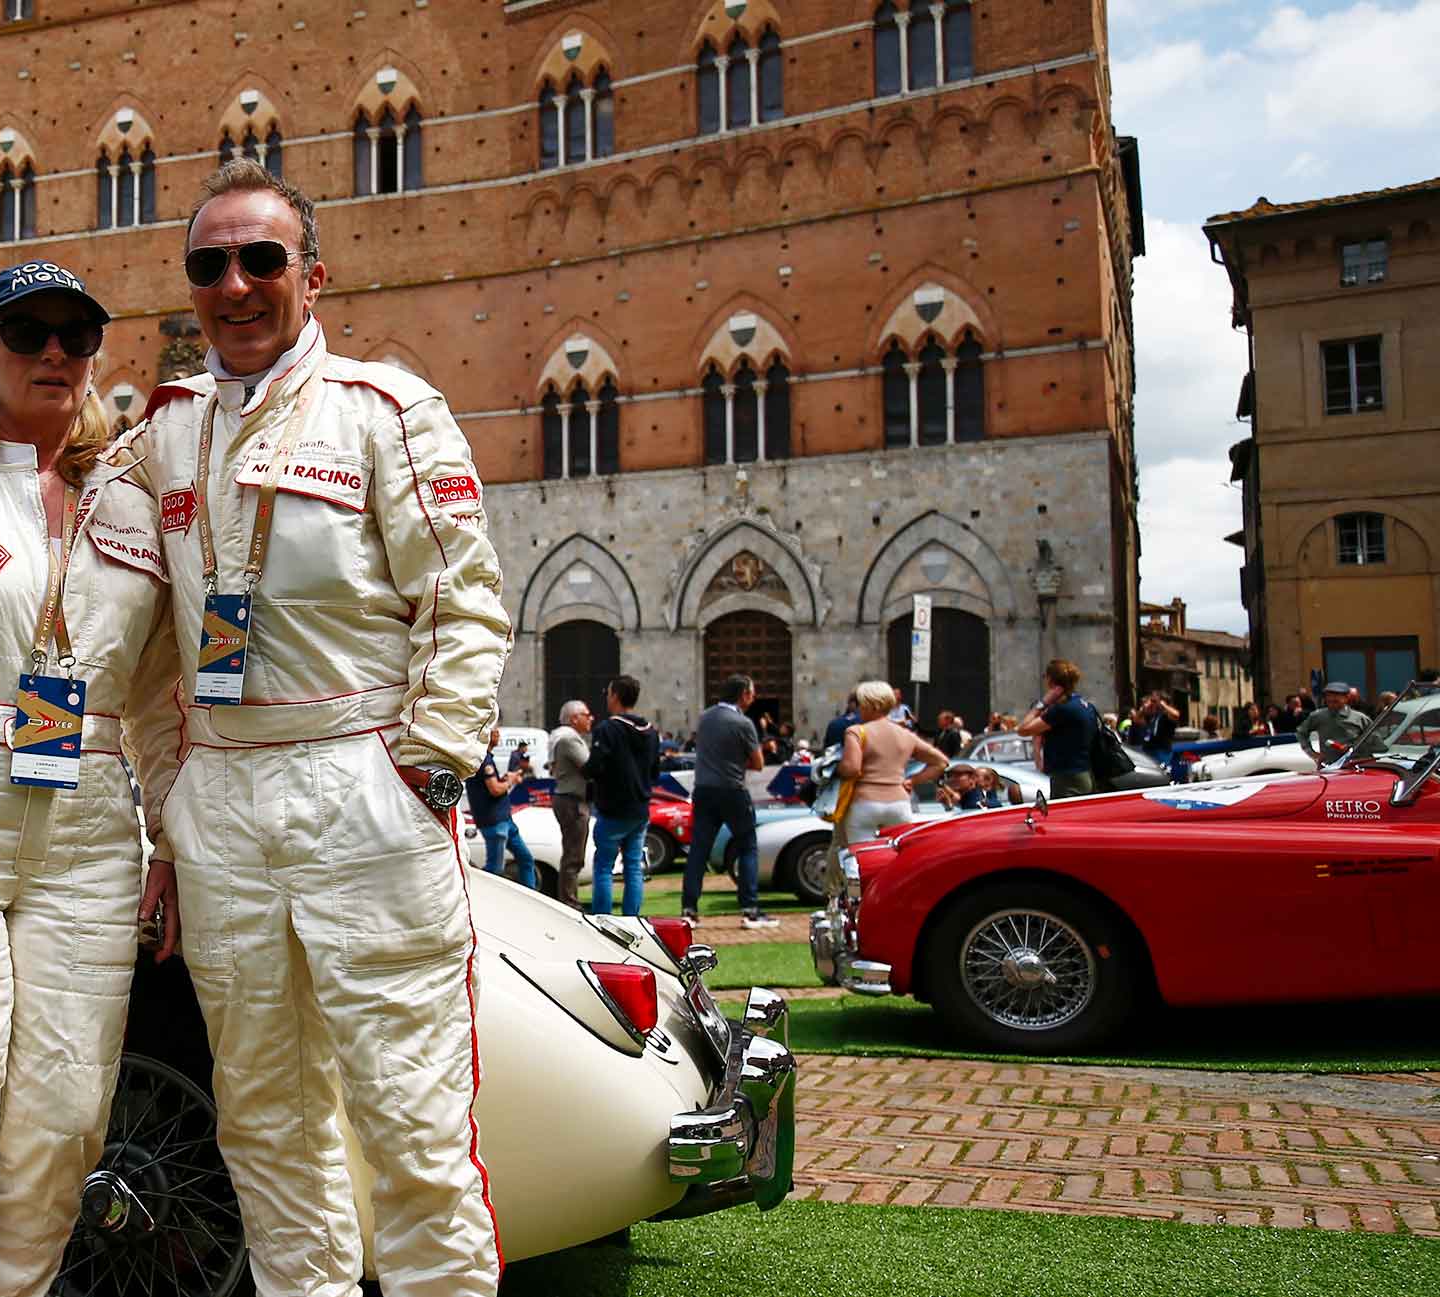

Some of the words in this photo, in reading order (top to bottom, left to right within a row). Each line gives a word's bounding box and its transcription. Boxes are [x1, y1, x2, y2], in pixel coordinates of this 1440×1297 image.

[12, 263, 76, 280] 1000
[11, 271, 84, 292] MIGLIA
[293, 465, 362, 490] RACING
[435, 478, 468, 490] 1000
[437, 490, 474, 502] MIGLIA
[208, 637, 240, 645] DRIVER
[27, 718, 73, 730] DRIVER
[1325, 800, 1381, 813] RETRO
